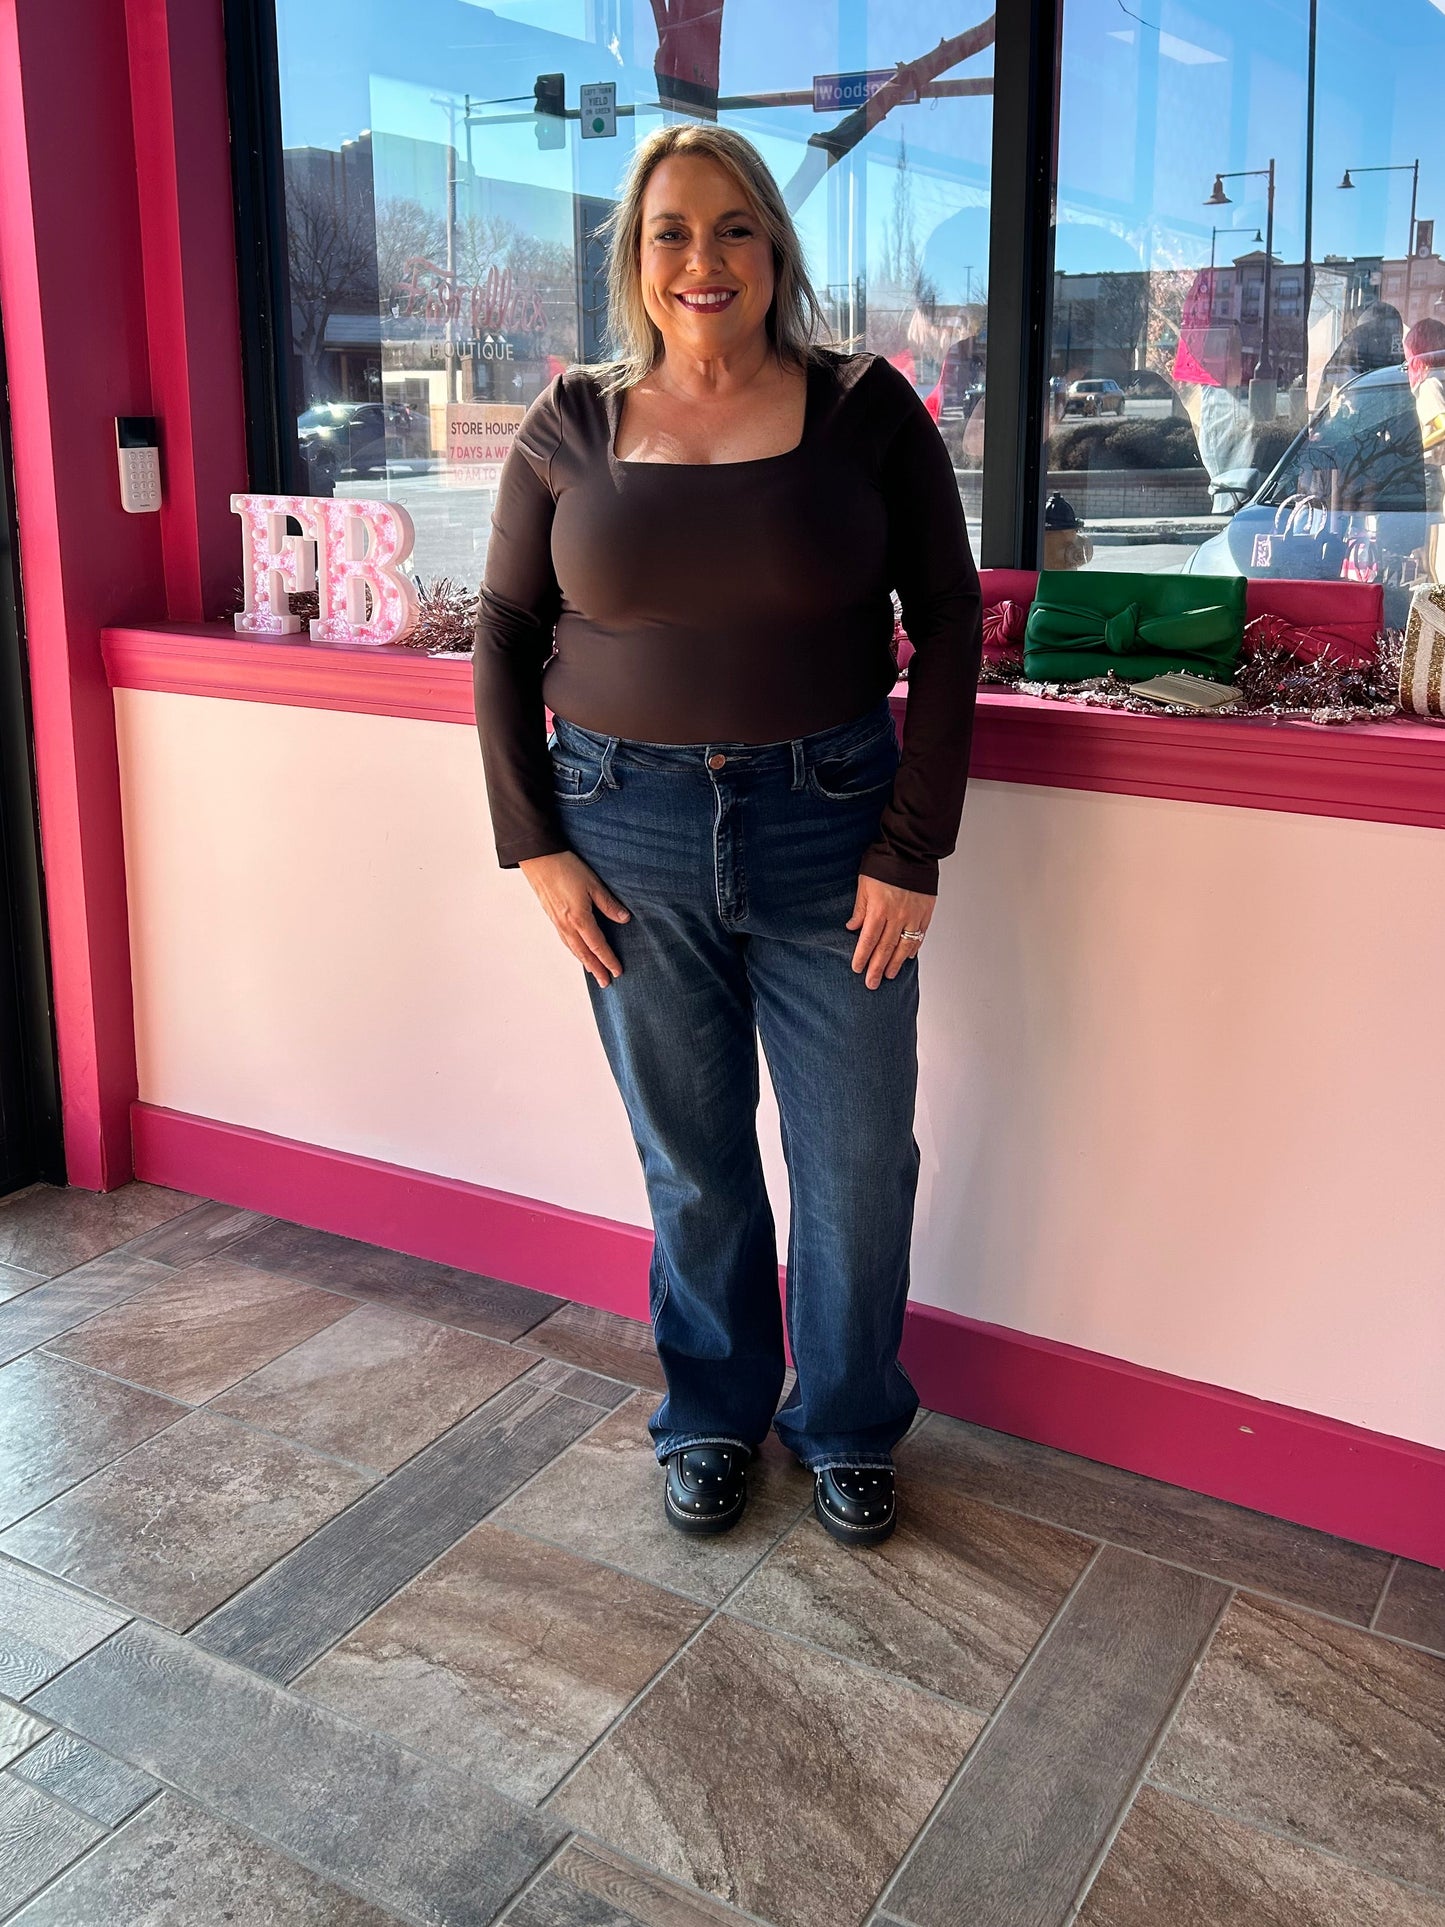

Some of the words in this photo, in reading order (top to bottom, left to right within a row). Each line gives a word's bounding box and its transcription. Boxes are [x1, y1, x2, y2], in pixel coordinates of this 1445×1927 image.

[819, 82, 886, 100] Woodso
[588, 96, 608, 106] YIELD
[431, 341, 514, 361] BOUTIQUE
[451, 421, 483, 435] STORE
[485, 422, 520, 435] HOURS
[450, 446, 455, 459] 7
[457, 446, 483, 459] DAYS
[485, 446, 492, 458] A
[465, 468, 481, 480] AM
[483, 467, 497, 480] TO
